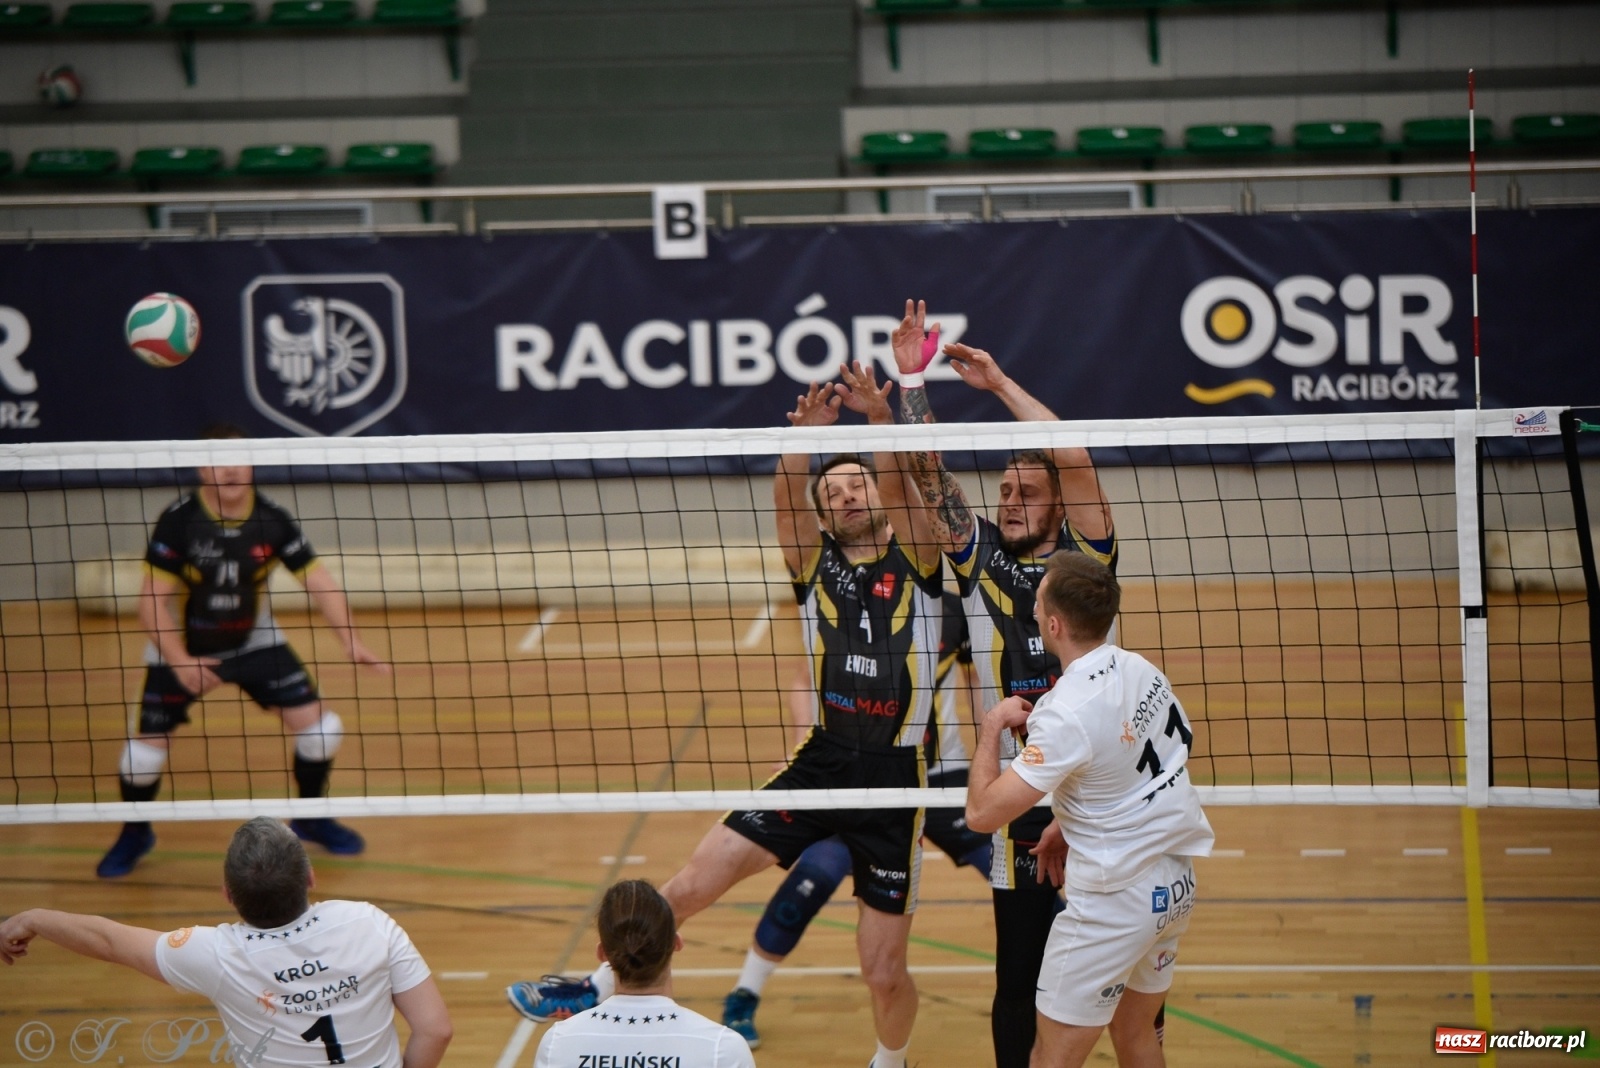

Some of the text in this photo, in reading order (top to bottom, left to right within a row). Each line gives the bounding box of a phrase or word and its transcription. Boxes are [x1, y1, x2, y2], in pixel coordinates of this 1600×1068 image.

[663, 201, 698, 241] B
[494, 292, 968, 392] RACIBÓRZ
[1290, 366, 1459, 402] RACIBÓRZ
[845, 653, 878, 678] ENTER
[1171, 867, 1195, 905] DK
[274, 959, 330, 985] KRÓL
[281, 975, 360, 1006] ZOO-MAR
[300, 1014, 346, 1066] 1
[578, 1051, 681, 1068] ZIELIŃSKI
